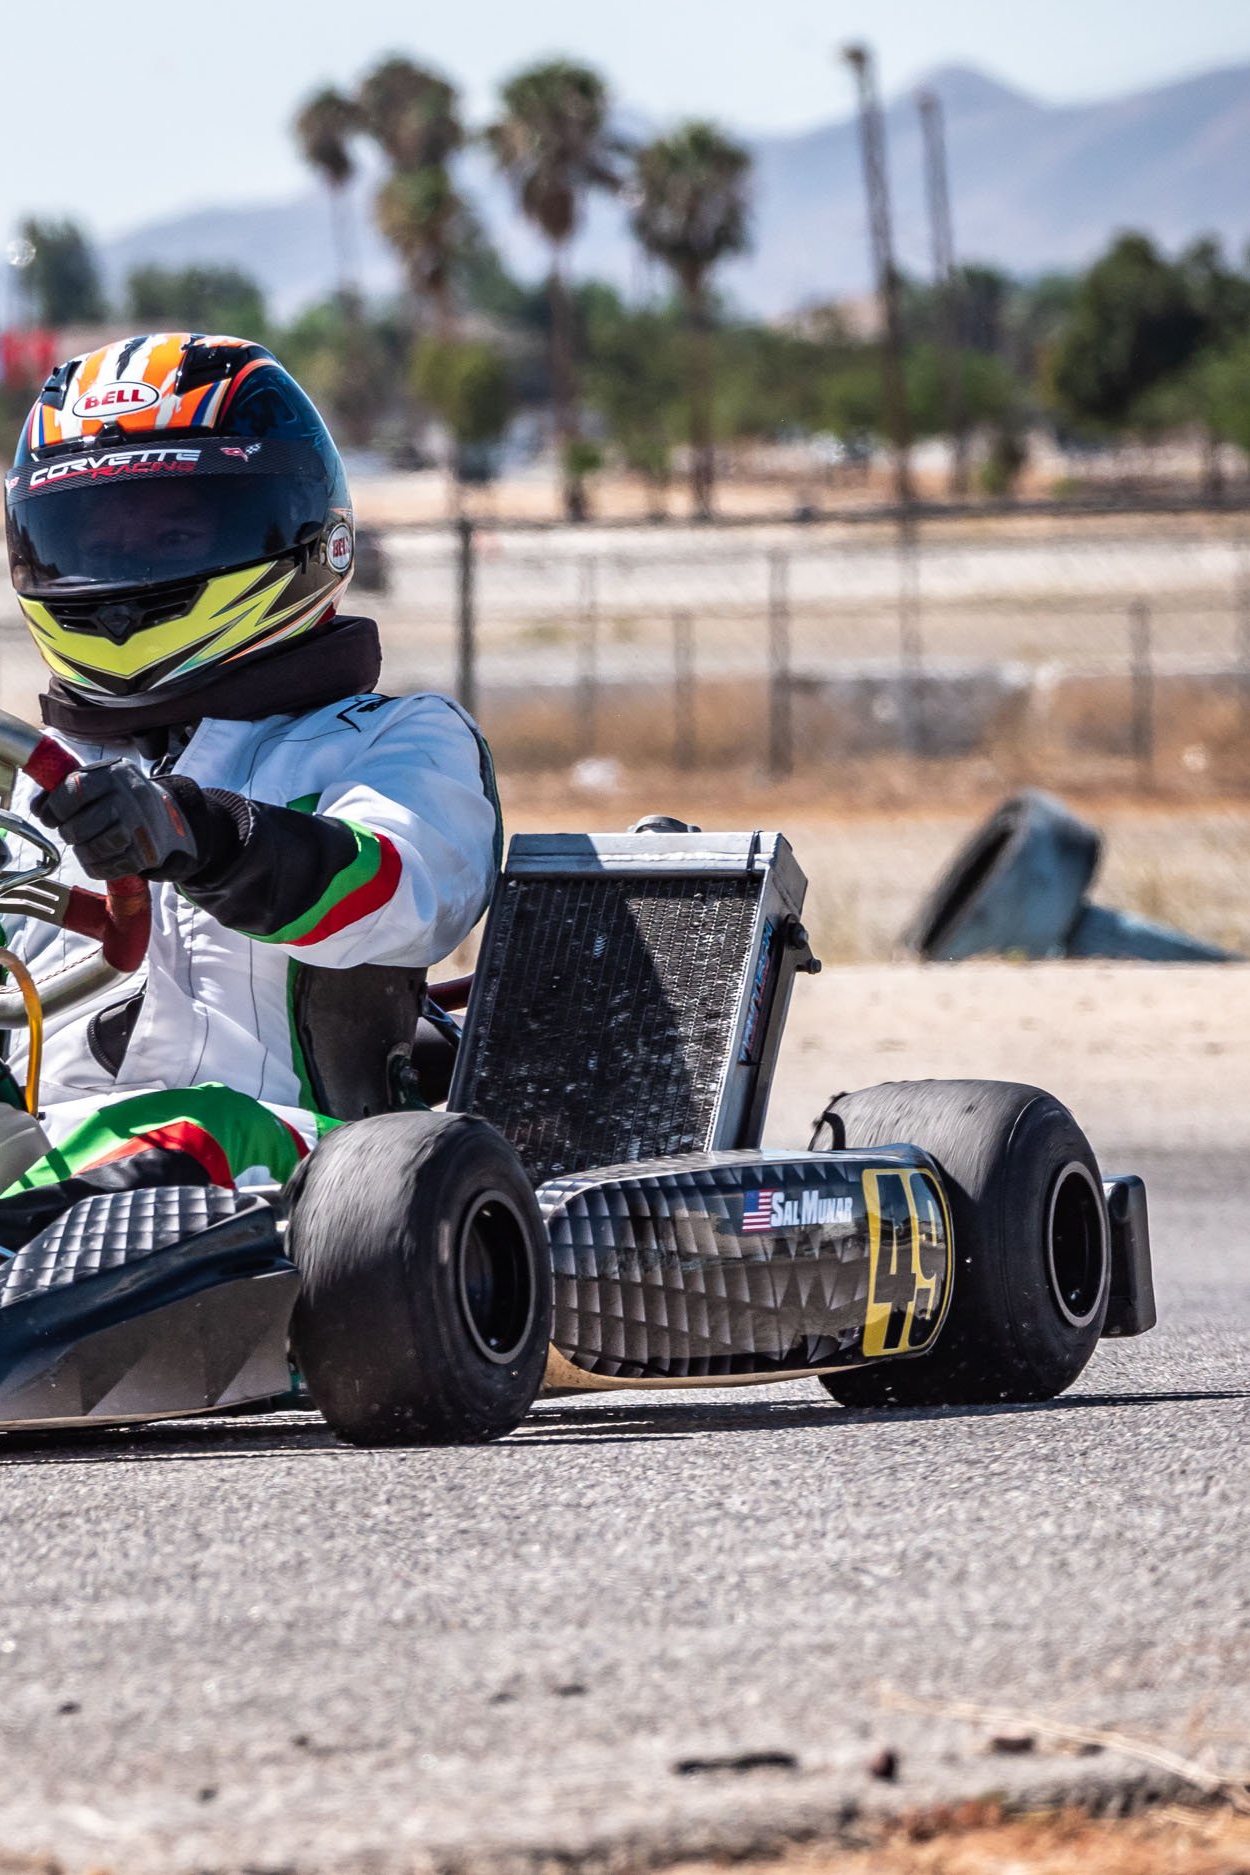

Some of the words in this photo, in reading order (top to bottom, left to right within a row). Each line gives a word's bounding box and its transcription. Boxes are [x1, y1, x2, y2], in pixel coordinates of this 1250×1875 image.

[84, 389, 146, 410] BELL
[30, 449, 202, 486] CORVETTE
[90, 461, 197, 479] RACING
[873, 1172, 948, 1350] 49
